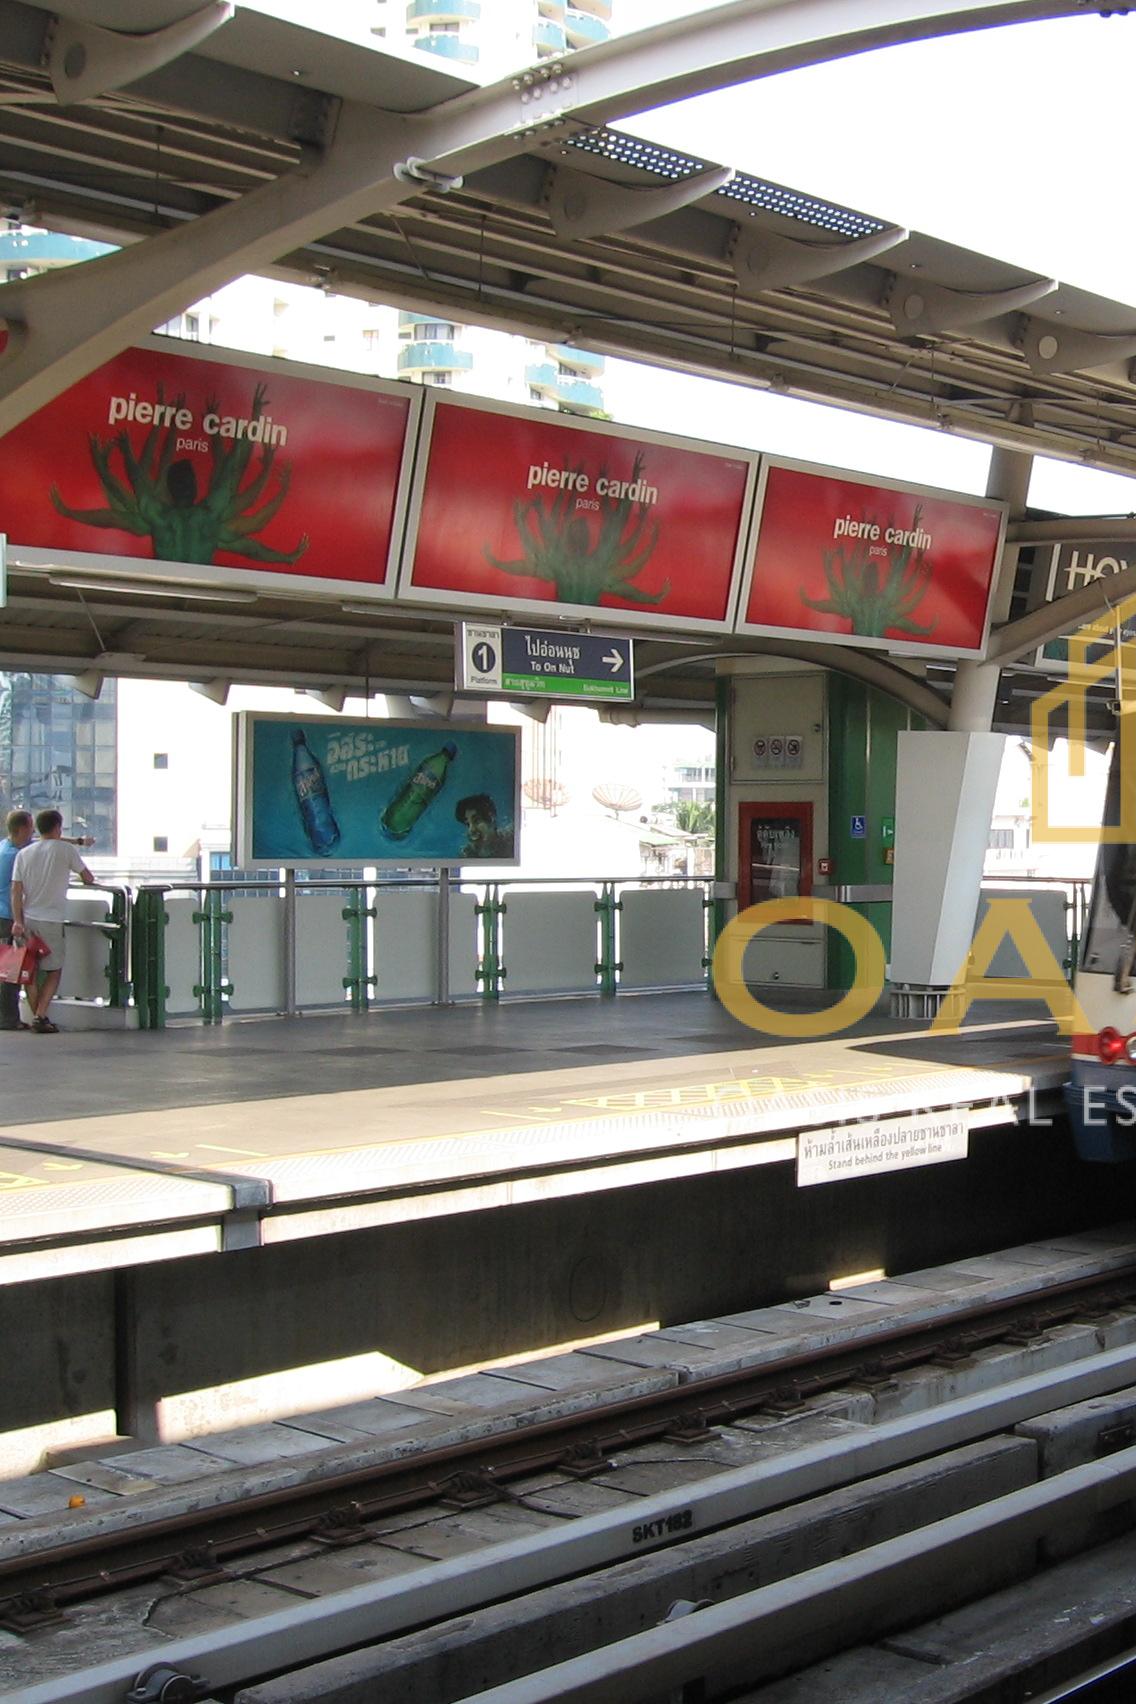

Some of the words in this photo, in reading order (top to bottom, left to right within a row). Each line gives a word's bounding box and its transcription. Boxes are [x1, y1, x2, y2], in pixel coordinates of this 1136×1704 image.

[108, 393, 193, 430] pierre
[203, 413, 288, 446] cardin
[176, 437, 209, 452] paris
[527, 461, 589, 492] pierre
[596, 478, 658, 505] cardin
[575, 498, 600, 511] paris
[833, 514, 880, 540] pierre
[885, 527, 932, 550] cardin
[868, 545, 888, 556] paris
[477, 645, 487, 670] 1
[531, 661, 541, 671] To
[544, 662, 556, 673] On
[828, 1155, 852, 1170] Stand
[855, 1152, 883, 1167] behind
[885, 1149, 899, 1161] the
[901, 1145, 927, 1161] yellow
[928, 1143, 942, 1154] line
